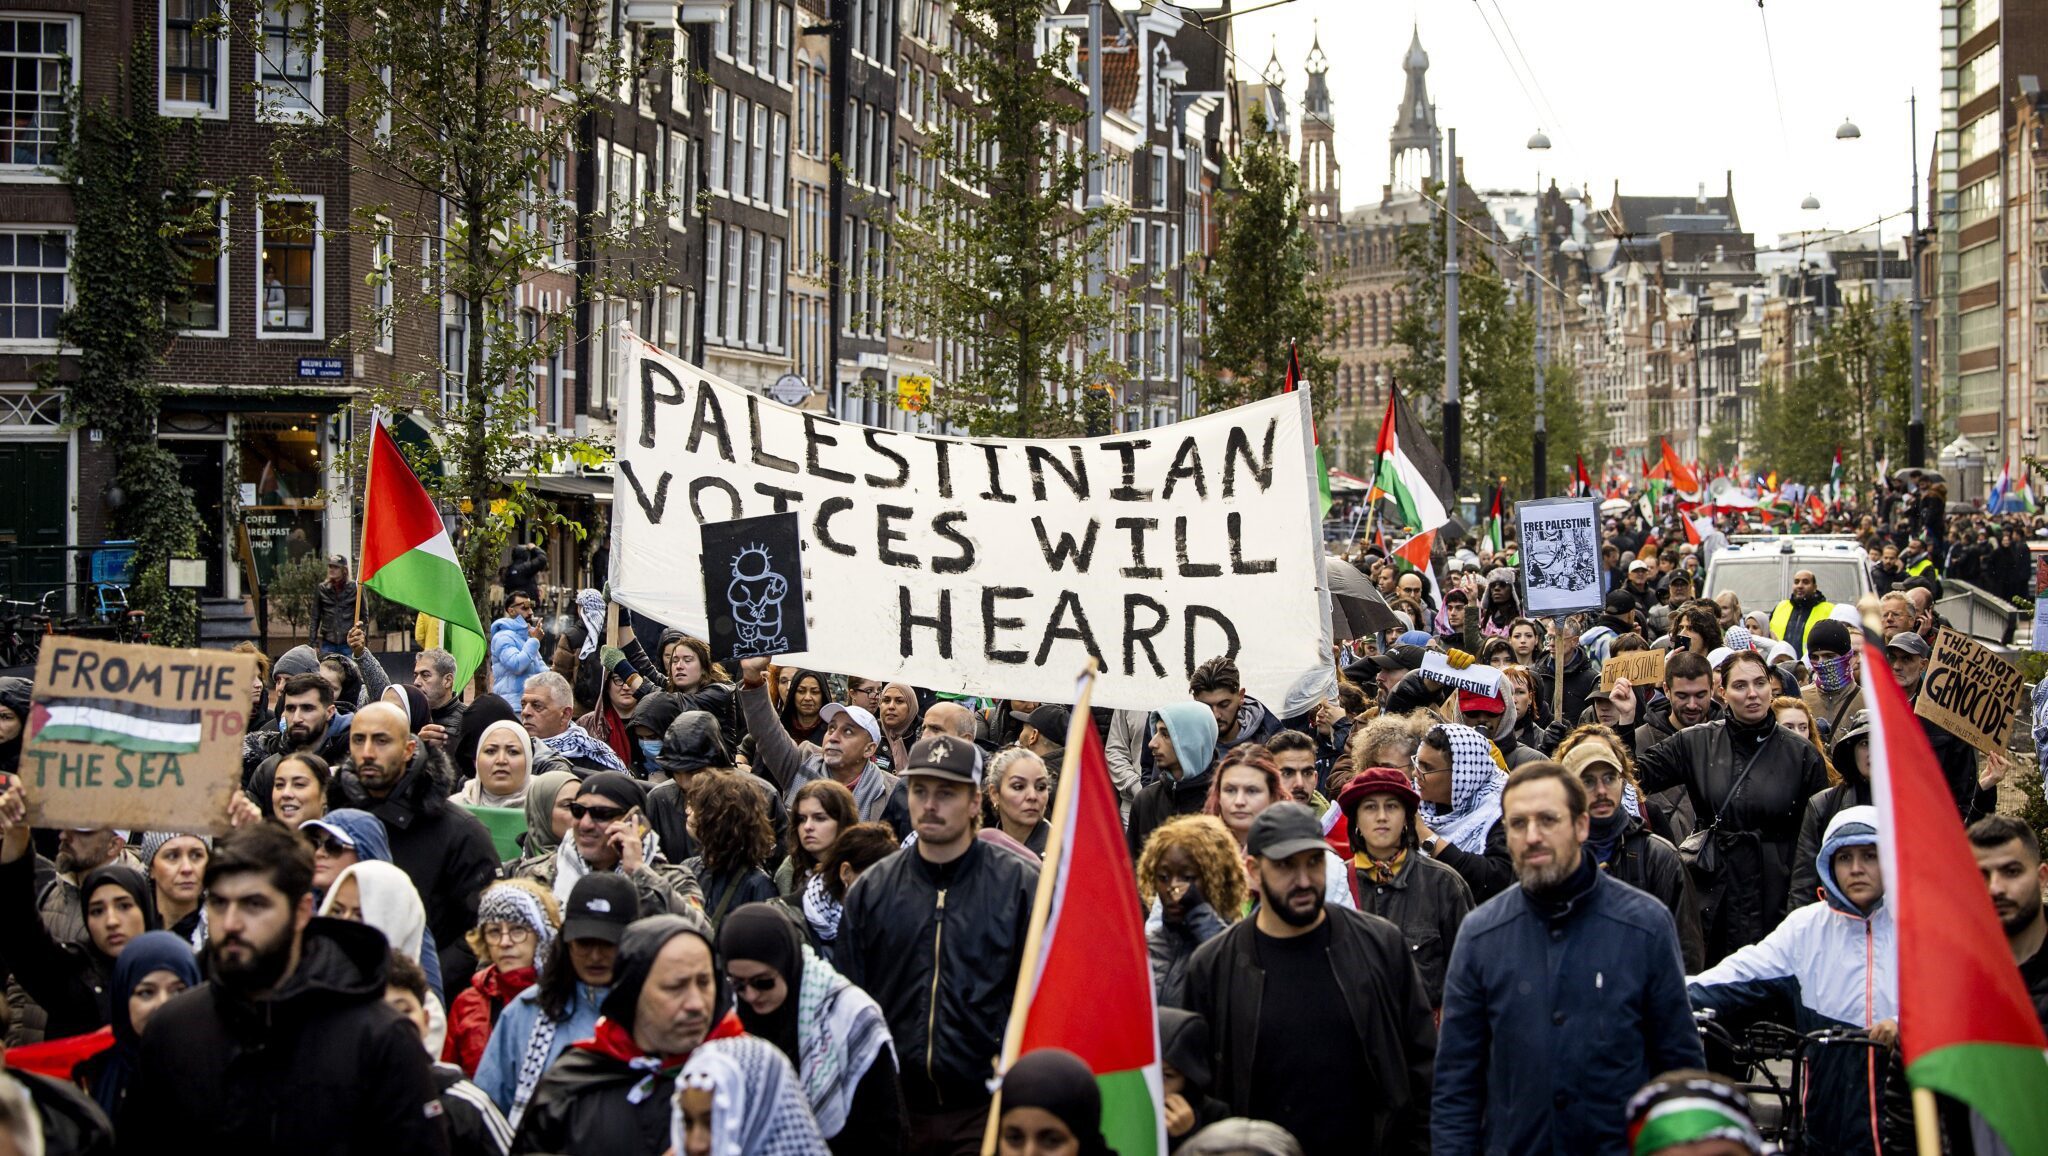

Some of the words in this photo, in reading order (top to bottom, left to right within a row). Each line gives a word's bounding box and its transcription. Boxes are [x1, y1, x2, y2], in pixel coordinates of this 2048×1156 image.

[639, 357, 1277, 504] PALESTINIAN
[245, 515, 277, 524] COFFEE
[1523, 521, 1544, 532] FREE
[1545, 517, 1591, 531] PALESTINE
[251, 540, 273, 549] UNCH
[1031, 512, 1277, 579] WILL
[900, 584, 1240, 682] HEARD
[49, 648, 162, 697] FROM
[170, 665, 236, 701] THE
[1422, 669, 1443, 684] FREE
[1444, 675, 1491, 696] PALESTINE
[1943, 631, 1972, 656] THIS
[1972, 645, 1987, 665] IS
[1985, 655, 2015, 682] NOT
[2010, 674, 2023, 692] A
[1964, 659, 1995, 687] THIS
[1992, 678, 2007, 698] IS
[2003, 688, 2016, 707] A
[205, 710, 243, 742] TO
[1926, 667, 2015, 747] GENOCIDE
[28, 750, 104, 788] THE
[114, 750, 185, 789] SEA
